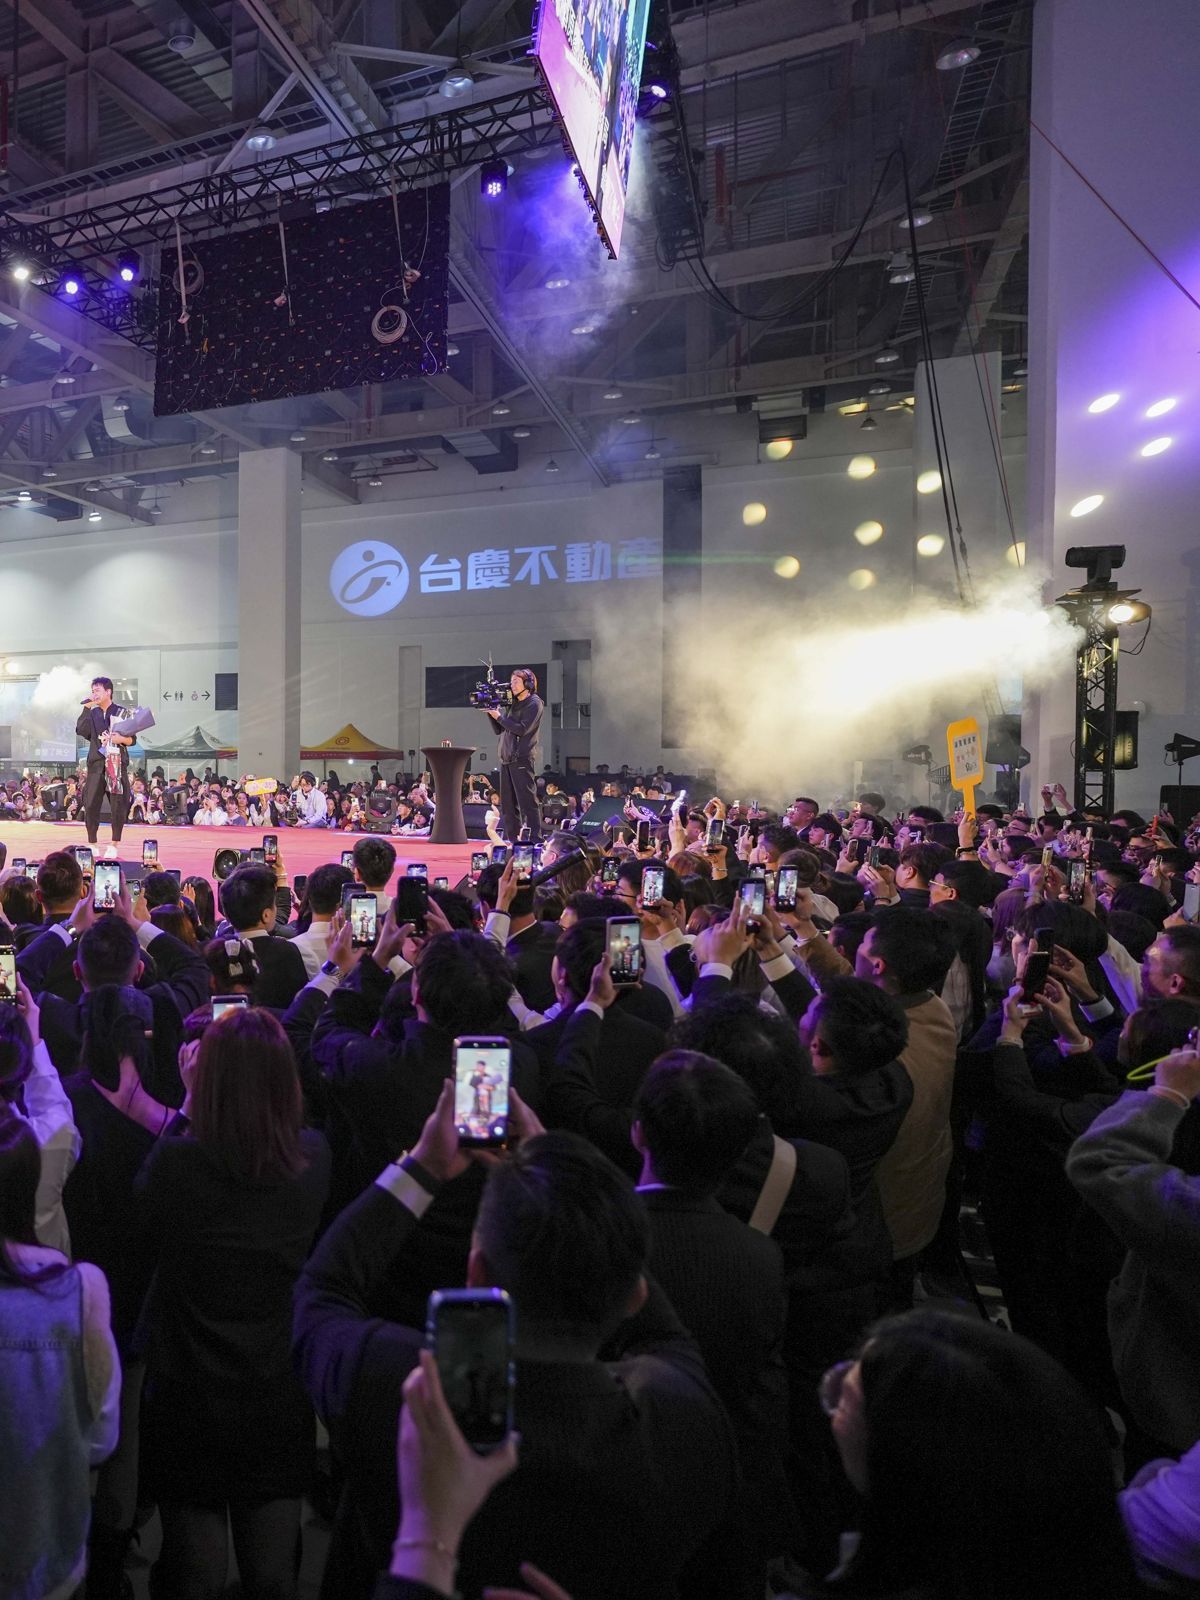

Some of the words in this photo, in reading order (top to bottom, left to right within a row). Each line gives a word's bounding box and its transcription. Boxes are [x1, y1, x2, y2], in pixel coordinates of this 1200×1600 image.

[419, 537, 663, 593] 台慶不動產
